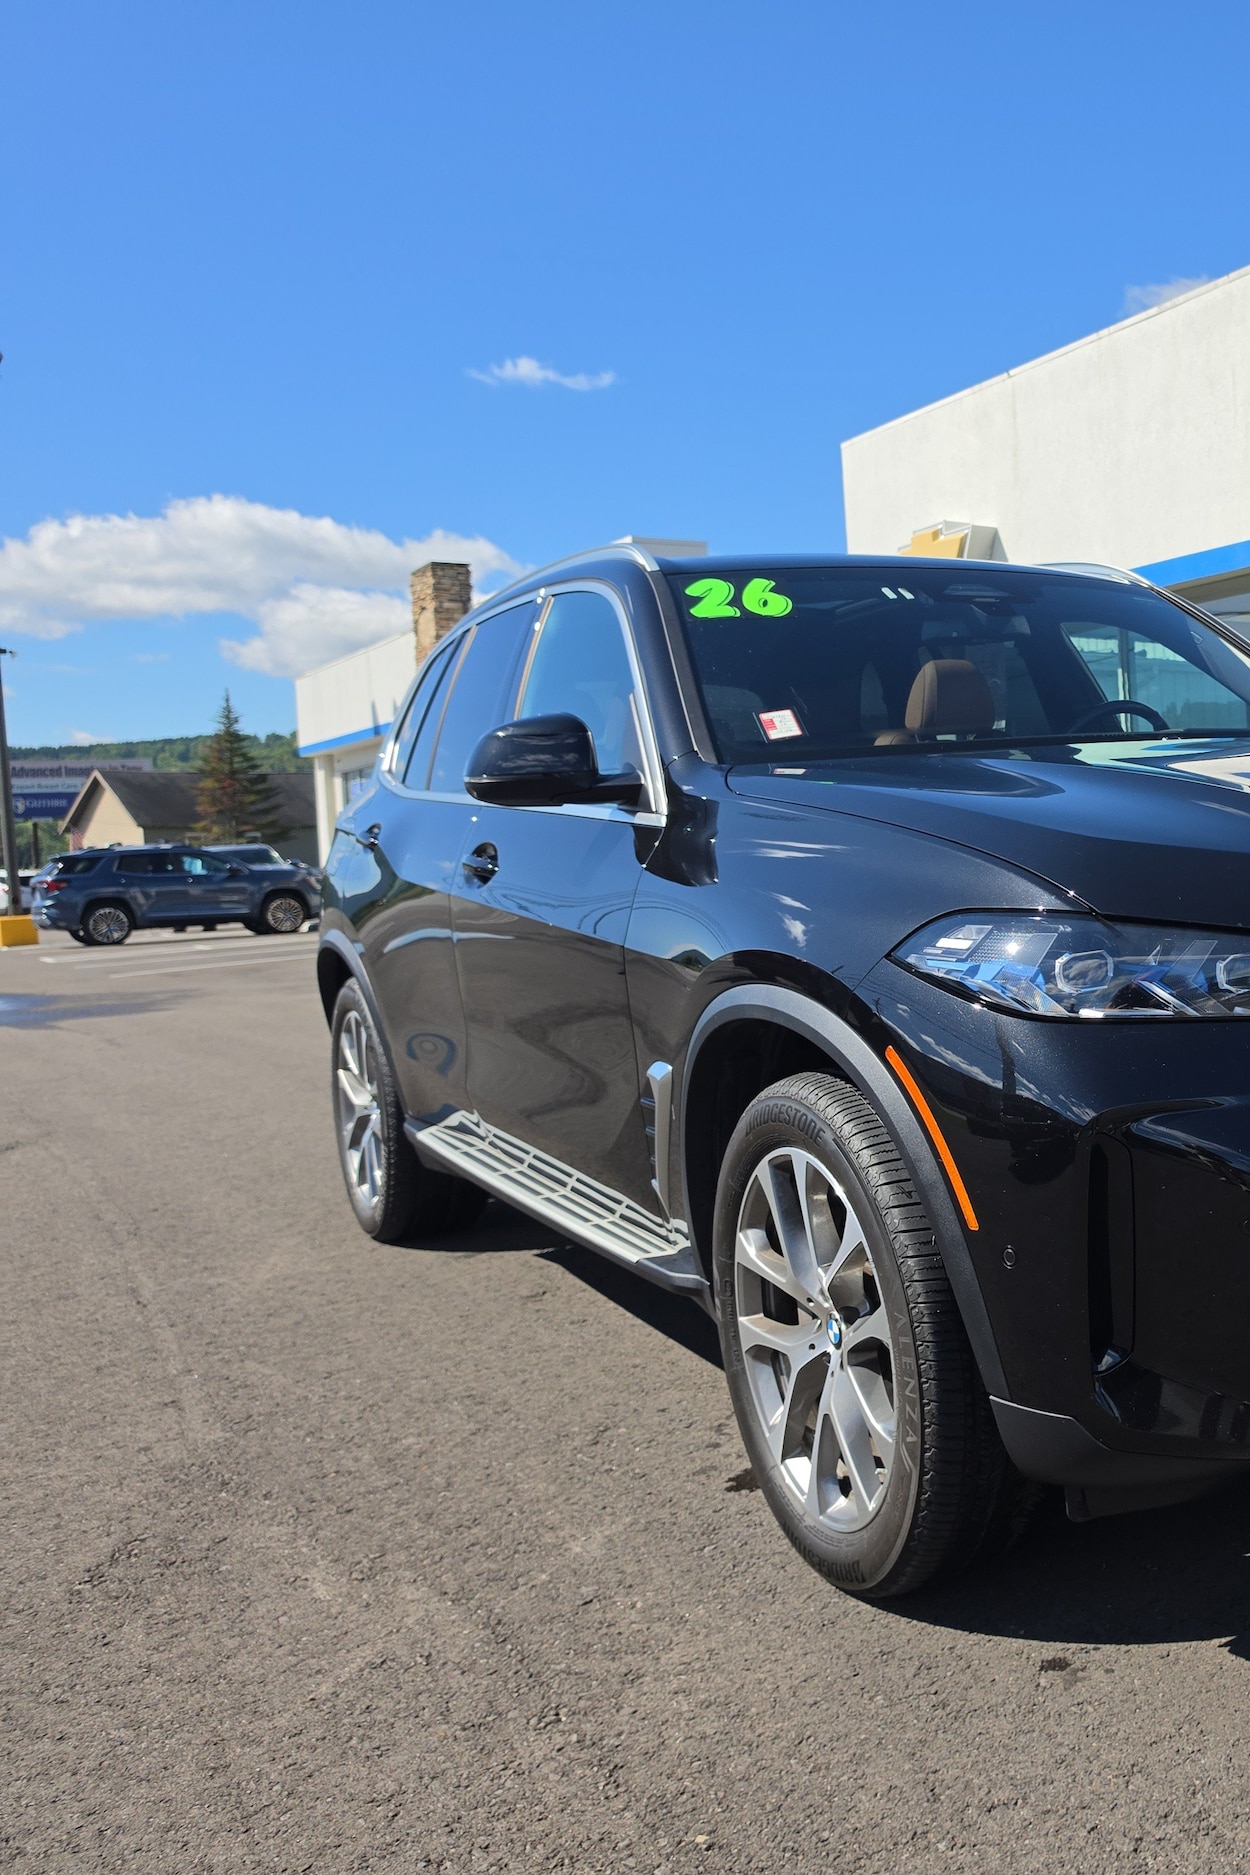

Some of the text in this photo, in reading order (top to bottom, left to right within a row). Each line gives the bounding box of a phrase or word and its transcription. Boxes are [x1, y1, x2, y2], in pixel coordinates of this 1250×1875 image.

[684, 577, 793, 619] 26
[11, 766, 62, 778] Advanced
[25, 798, 68, 808] GUTHRIE
[745, 1103, 826, 1148] BRIDGESTONE
[893, 1311, 919, 1443] ALENZA
